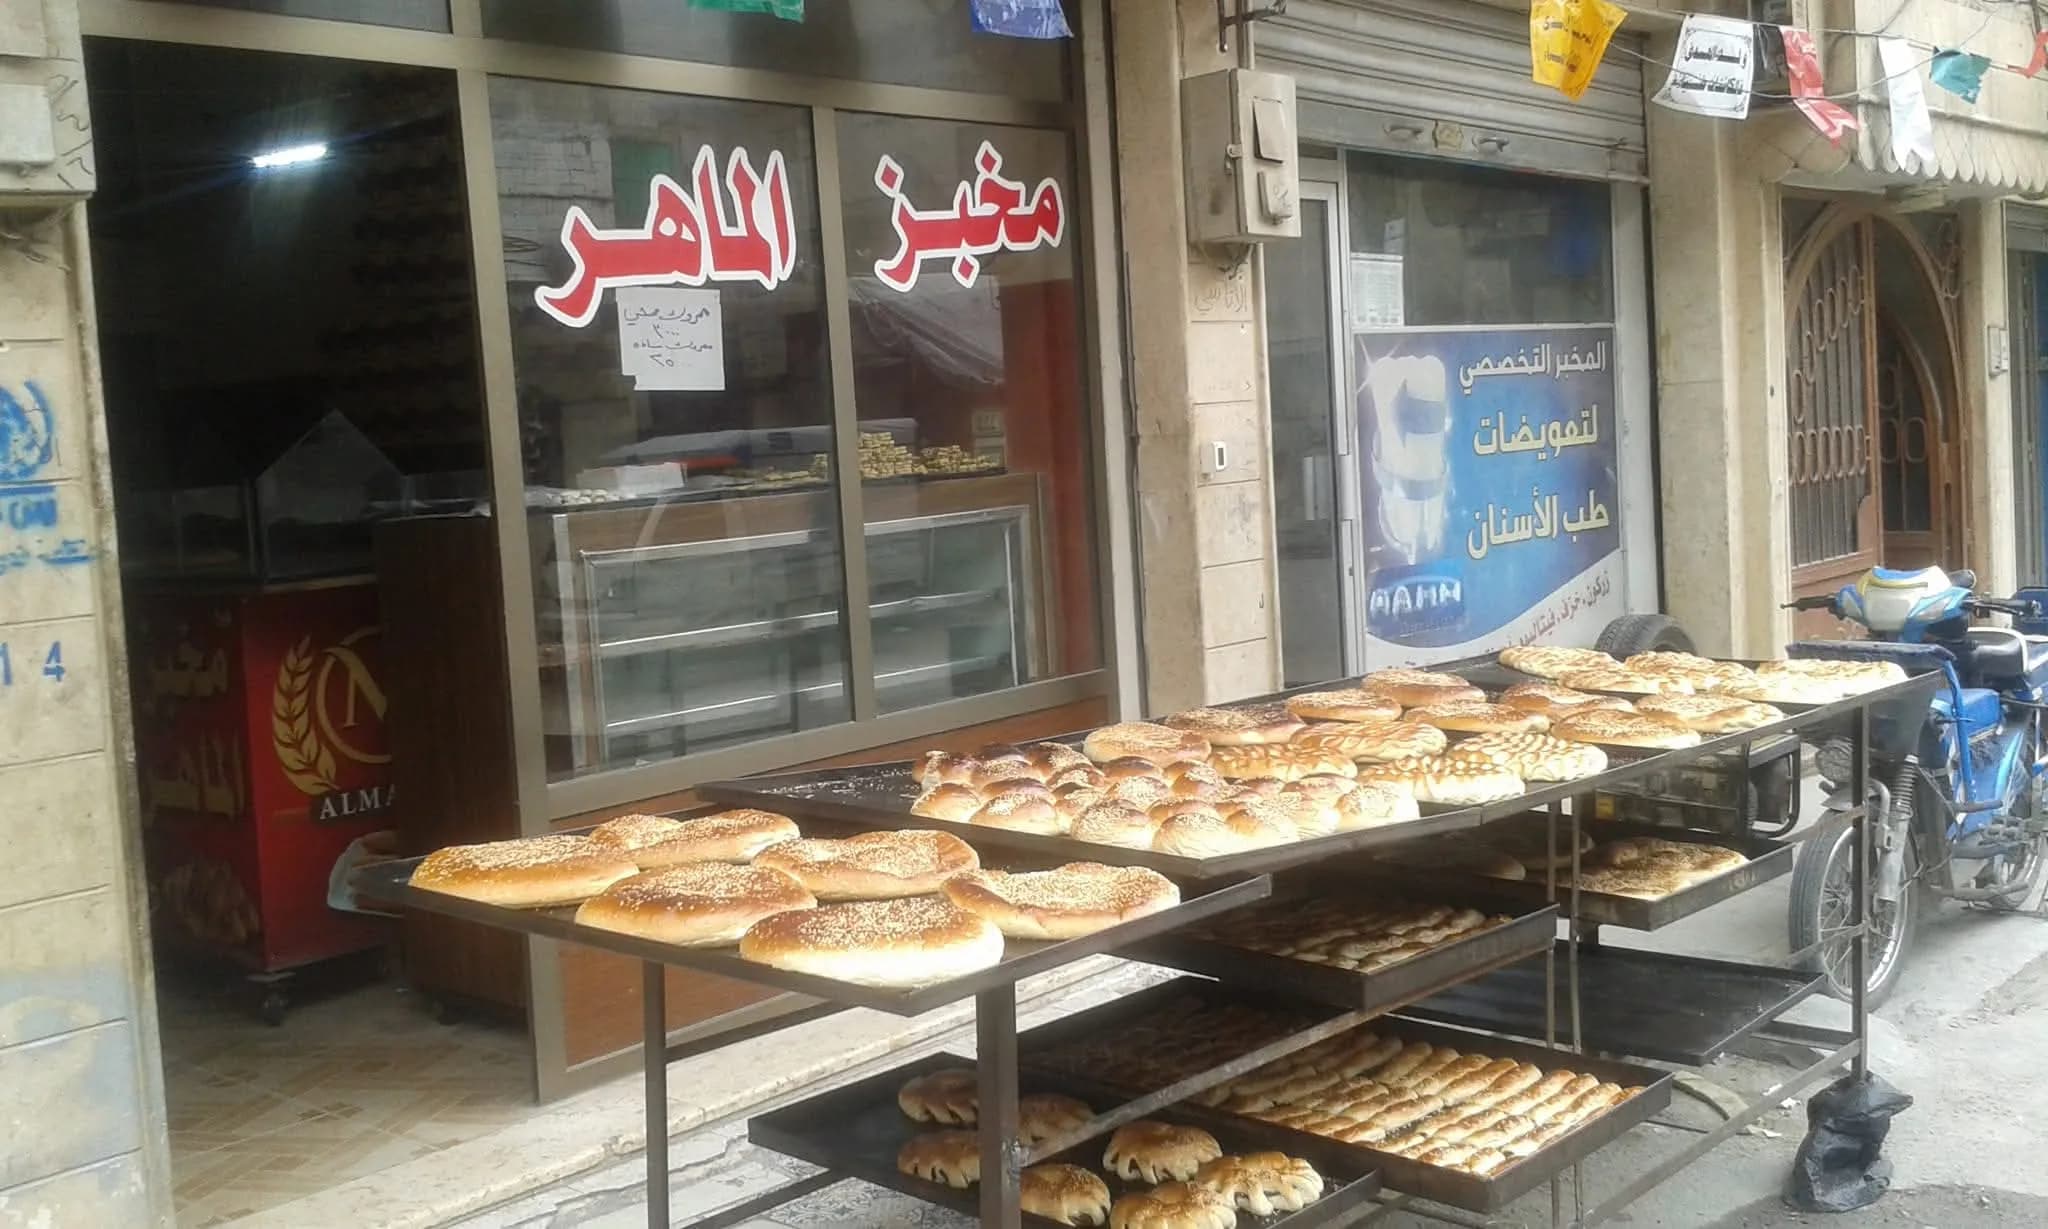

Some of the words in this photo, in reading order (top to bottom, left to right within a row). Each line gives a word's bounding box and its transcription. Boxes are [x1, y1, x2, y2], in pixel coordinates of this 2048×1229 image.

[534, 144, 797, 328] الماهر
[873, 140, 1065, 292] مخبز
[1458, 342, 1551, 396] التخصصي
[1553, 340, 1607, 380] المخبر
[1473, 404, 1600, 461] لتعويضات
[1466, 485, 1559, 561] الأسنان
[1562, 489, 1611, 544] طب
